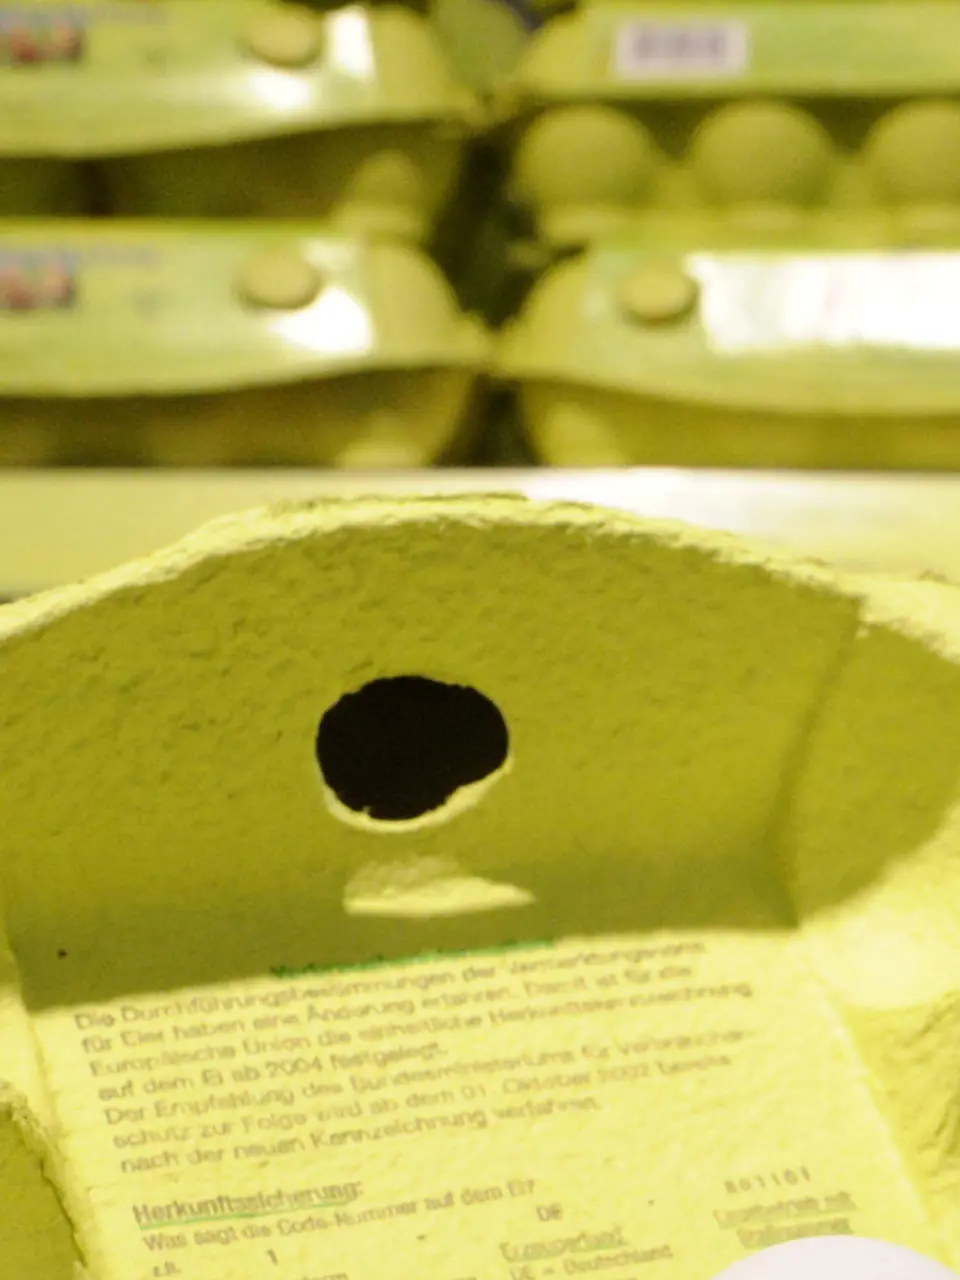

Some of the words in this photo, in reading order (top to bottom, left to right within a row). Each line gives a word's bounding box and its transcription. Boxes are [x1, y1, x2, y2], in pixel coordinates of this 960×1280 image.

[75, 1012, 116, 1030] Die
[462, 965, 495, 982] der
[81, 1037, 112, 1055] für
[120, 1030, 164, 1047] Eier
[172, 1019, 245, 1041] haben
[253, 1014, 299, 1030] eine
[307, 999, 415, 1023] Änderung
[89, 1045, 236, 1077] Europäische
[242, 1036, 311, 1055] Union
[317, 1030, 352, 1047] die
[98, 1079, 134, 1101] auf
[143, 1076, 195, 1095] dem
[201, 1067, 224, 1087] Ei
[231, 1065, 261, 1082] ab
[265, 1056, 323, 1079] 2004
[104, 1107, 144, 1125] Der
[153, 1089, 295, 1119] Empfehlung
[301, 1080, 344, 1098] des
[112, 1127, 190, 1149] schutz
[200, 1120, 231, 1138] zur
[240, 1112, 307, 1135] Folge
[317, 1101, 363, 1121] wird
[369, 1097, 400, 1114] ab
[405, 1090, 454, 1109] dem
[502, 1071, 590, 1095] Oktober
[120, 1149, 179, 1173] nach
[187, 1148, 224, 1166] der
[233, 1138, 306, 1160] neuen
[310, 1109, 488, 1149] Kennzeichnung
[132, 1180, 364, 1225] Herkunftssicherung:
[142, 1232, 188, 1252] Was
[193, 1226, 239, 1246] sagt
[241, 1224, 272, 1240] die
[424, 1190, 454, 1212] auf
[460, 1185, 503, 1206] dem
[265, 1248, 278, 1266] 1
[536, 1202, 564, 1222] DE
